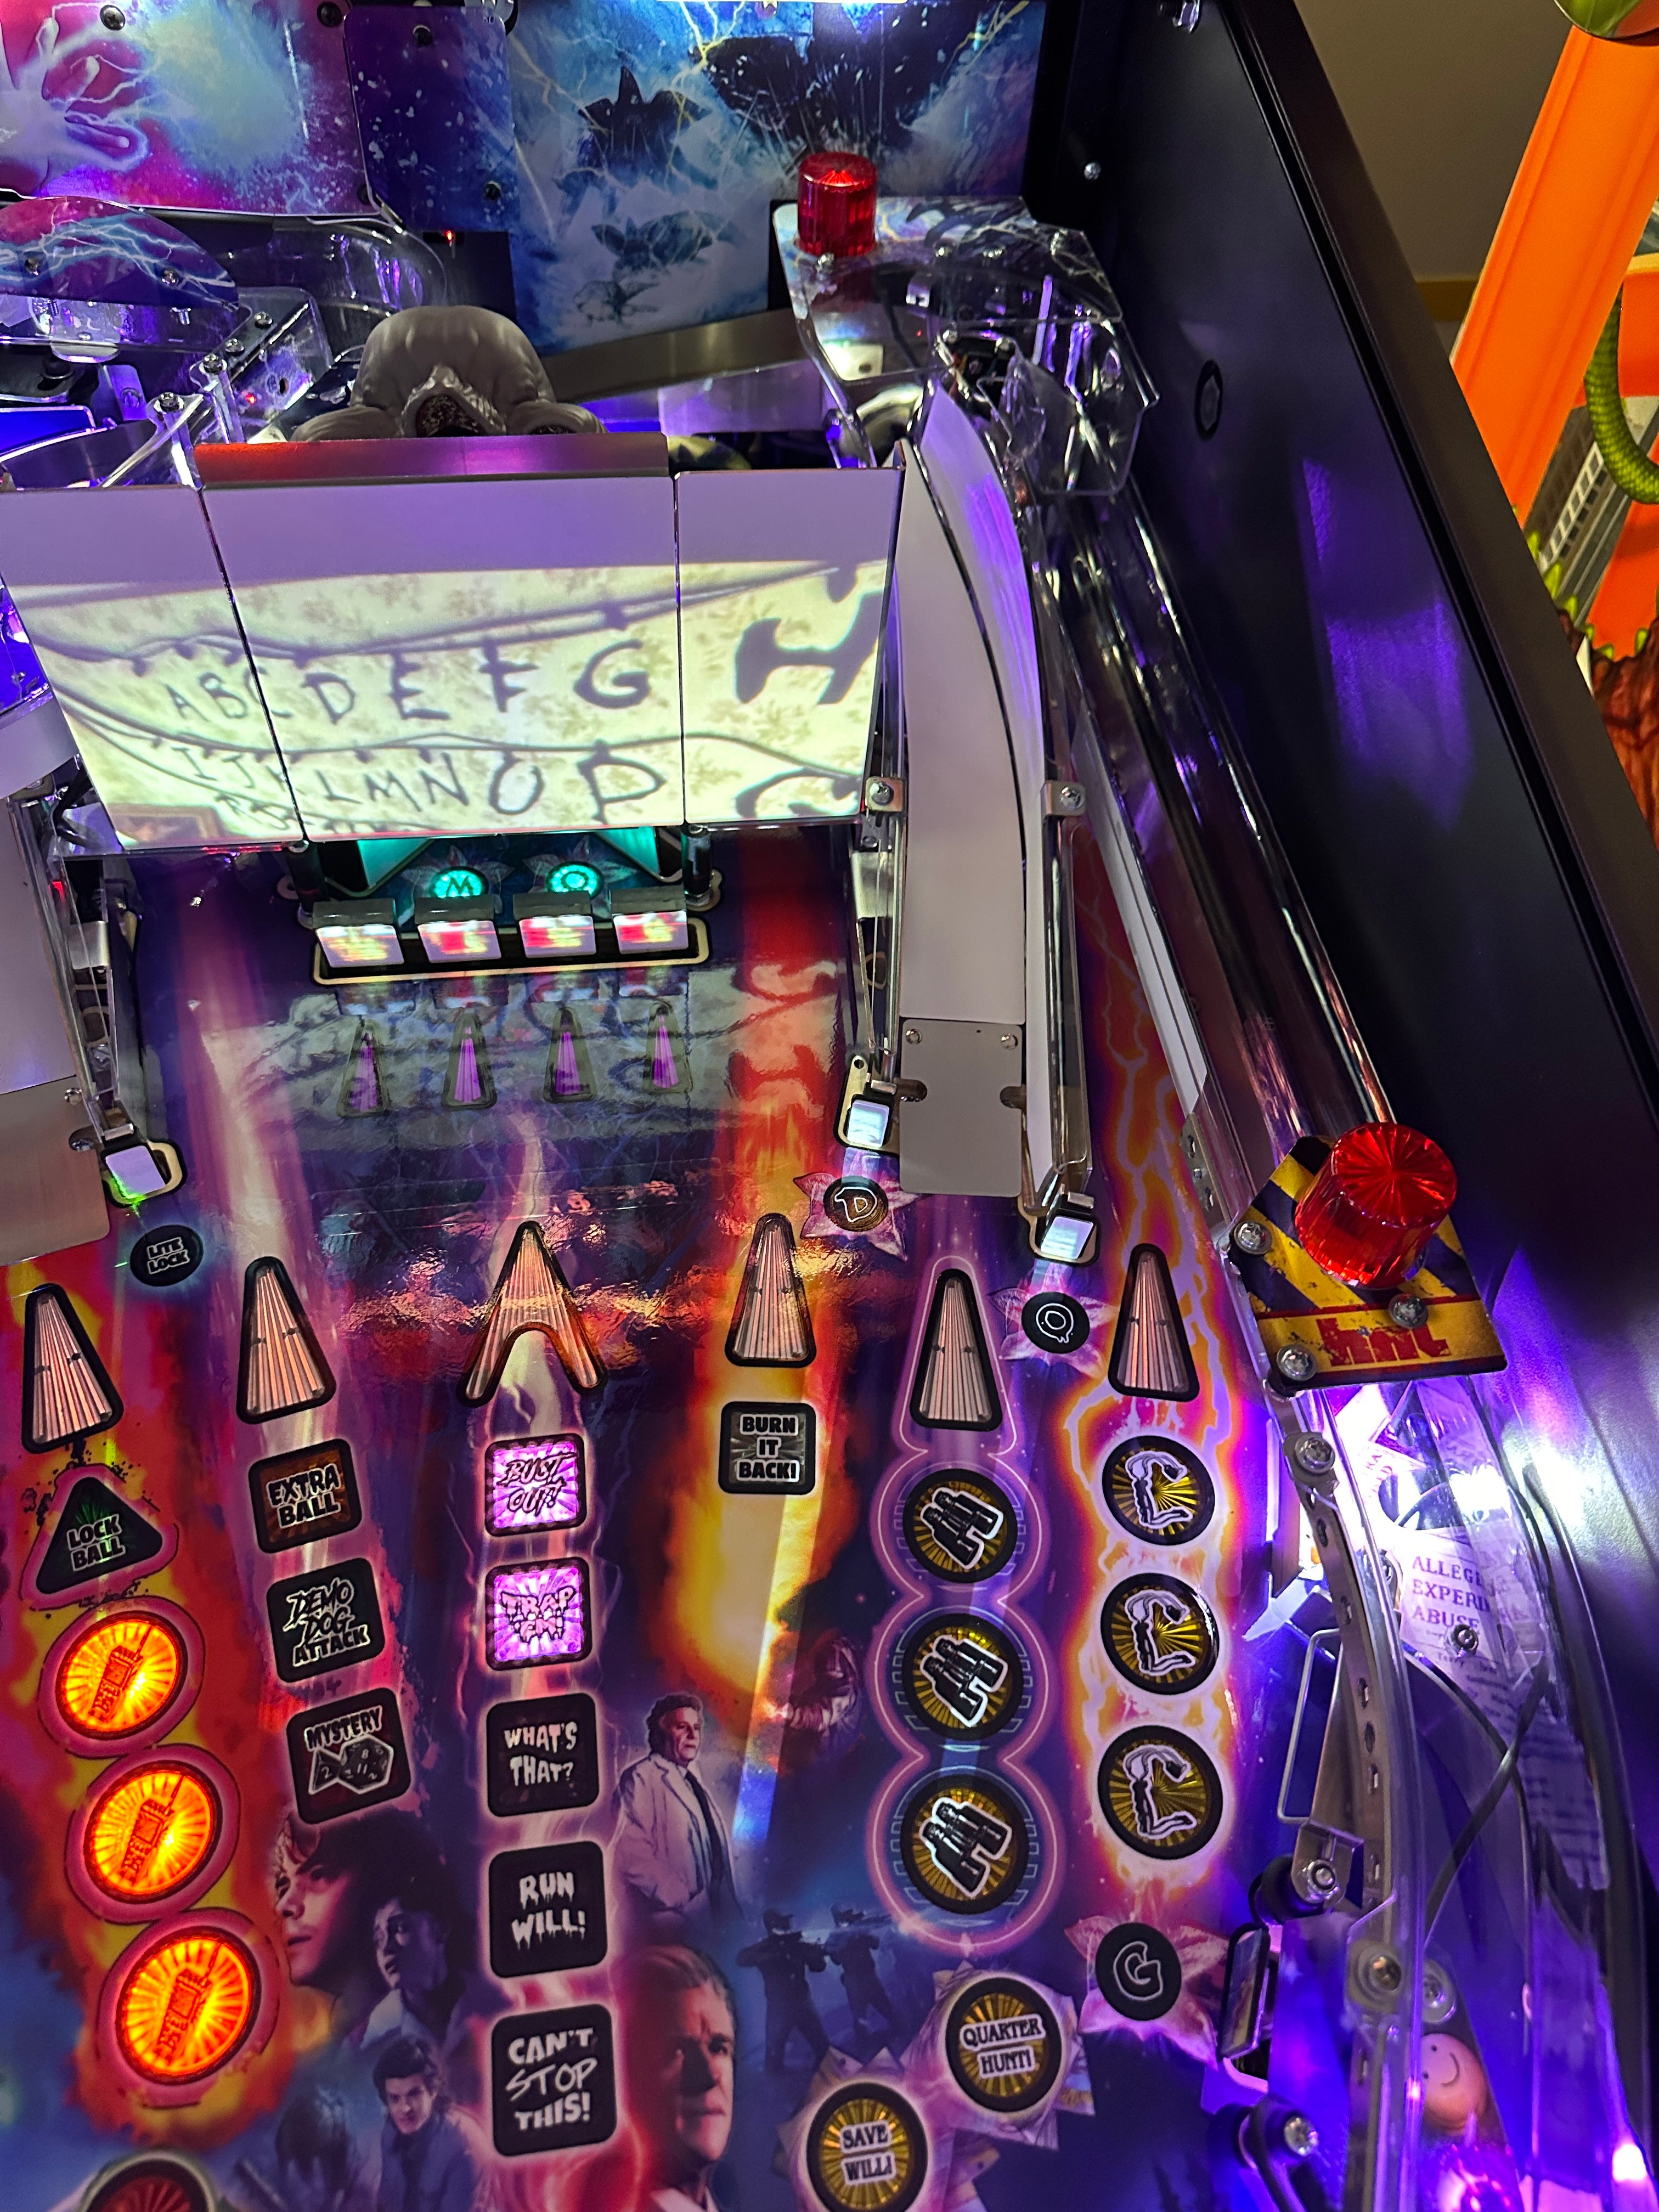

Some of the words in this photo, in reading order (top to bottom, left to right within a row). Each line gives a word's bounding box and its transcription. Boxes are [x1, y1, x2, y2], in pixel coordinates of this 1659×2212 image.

[146, 1237, 183, 1260] LITE
[147, 1249, 190, 1274] LOCK
[741, 1415, 798, 1435] BURN
[757, 1437, 781, 1458] IT
[267, 1464, 341, 1507] EXTRA
[497, 1452, 579, 1486] BUST
[737, 1460, 799, 1482] BACK!
[278, 1492, 341, 1528] BALL
[507, 1477, 565, 1516] OUT!
[67, 1514, 122, 1550] LOCK
[71, 1536, 126, 1571] BALL
[283, 1578, 354, 1631] DEMO
[500, 1585, 576, 1621] TRAP
[299, 1605, 356, 1645] DOG
[293, 1624, 370, 1667] ATTACK
[304, 1706, 382, 1751] MYSTERY
[504, 1721, 578, 1753] WHAT'S
[510, 1755, 574, 1786] THAT?
[519, 1871, 575, 1910] RUN
[511, 1909, 585, 1950] WILL!
[1114, 1941, 1163, 2000] G
[508, 2028, 594, 2065] CAN'T
[963, 2017, 1043, 2047] QUARTER
[506, 2057, 597, 2101] STOP
[980, 2048, 1033, 2075] HUNT!
[514, 2092, 591, 2131] THIS!
[842, 2123, 889, 2149] SAVE
[844, 2155, 893, 2182] WILL!
